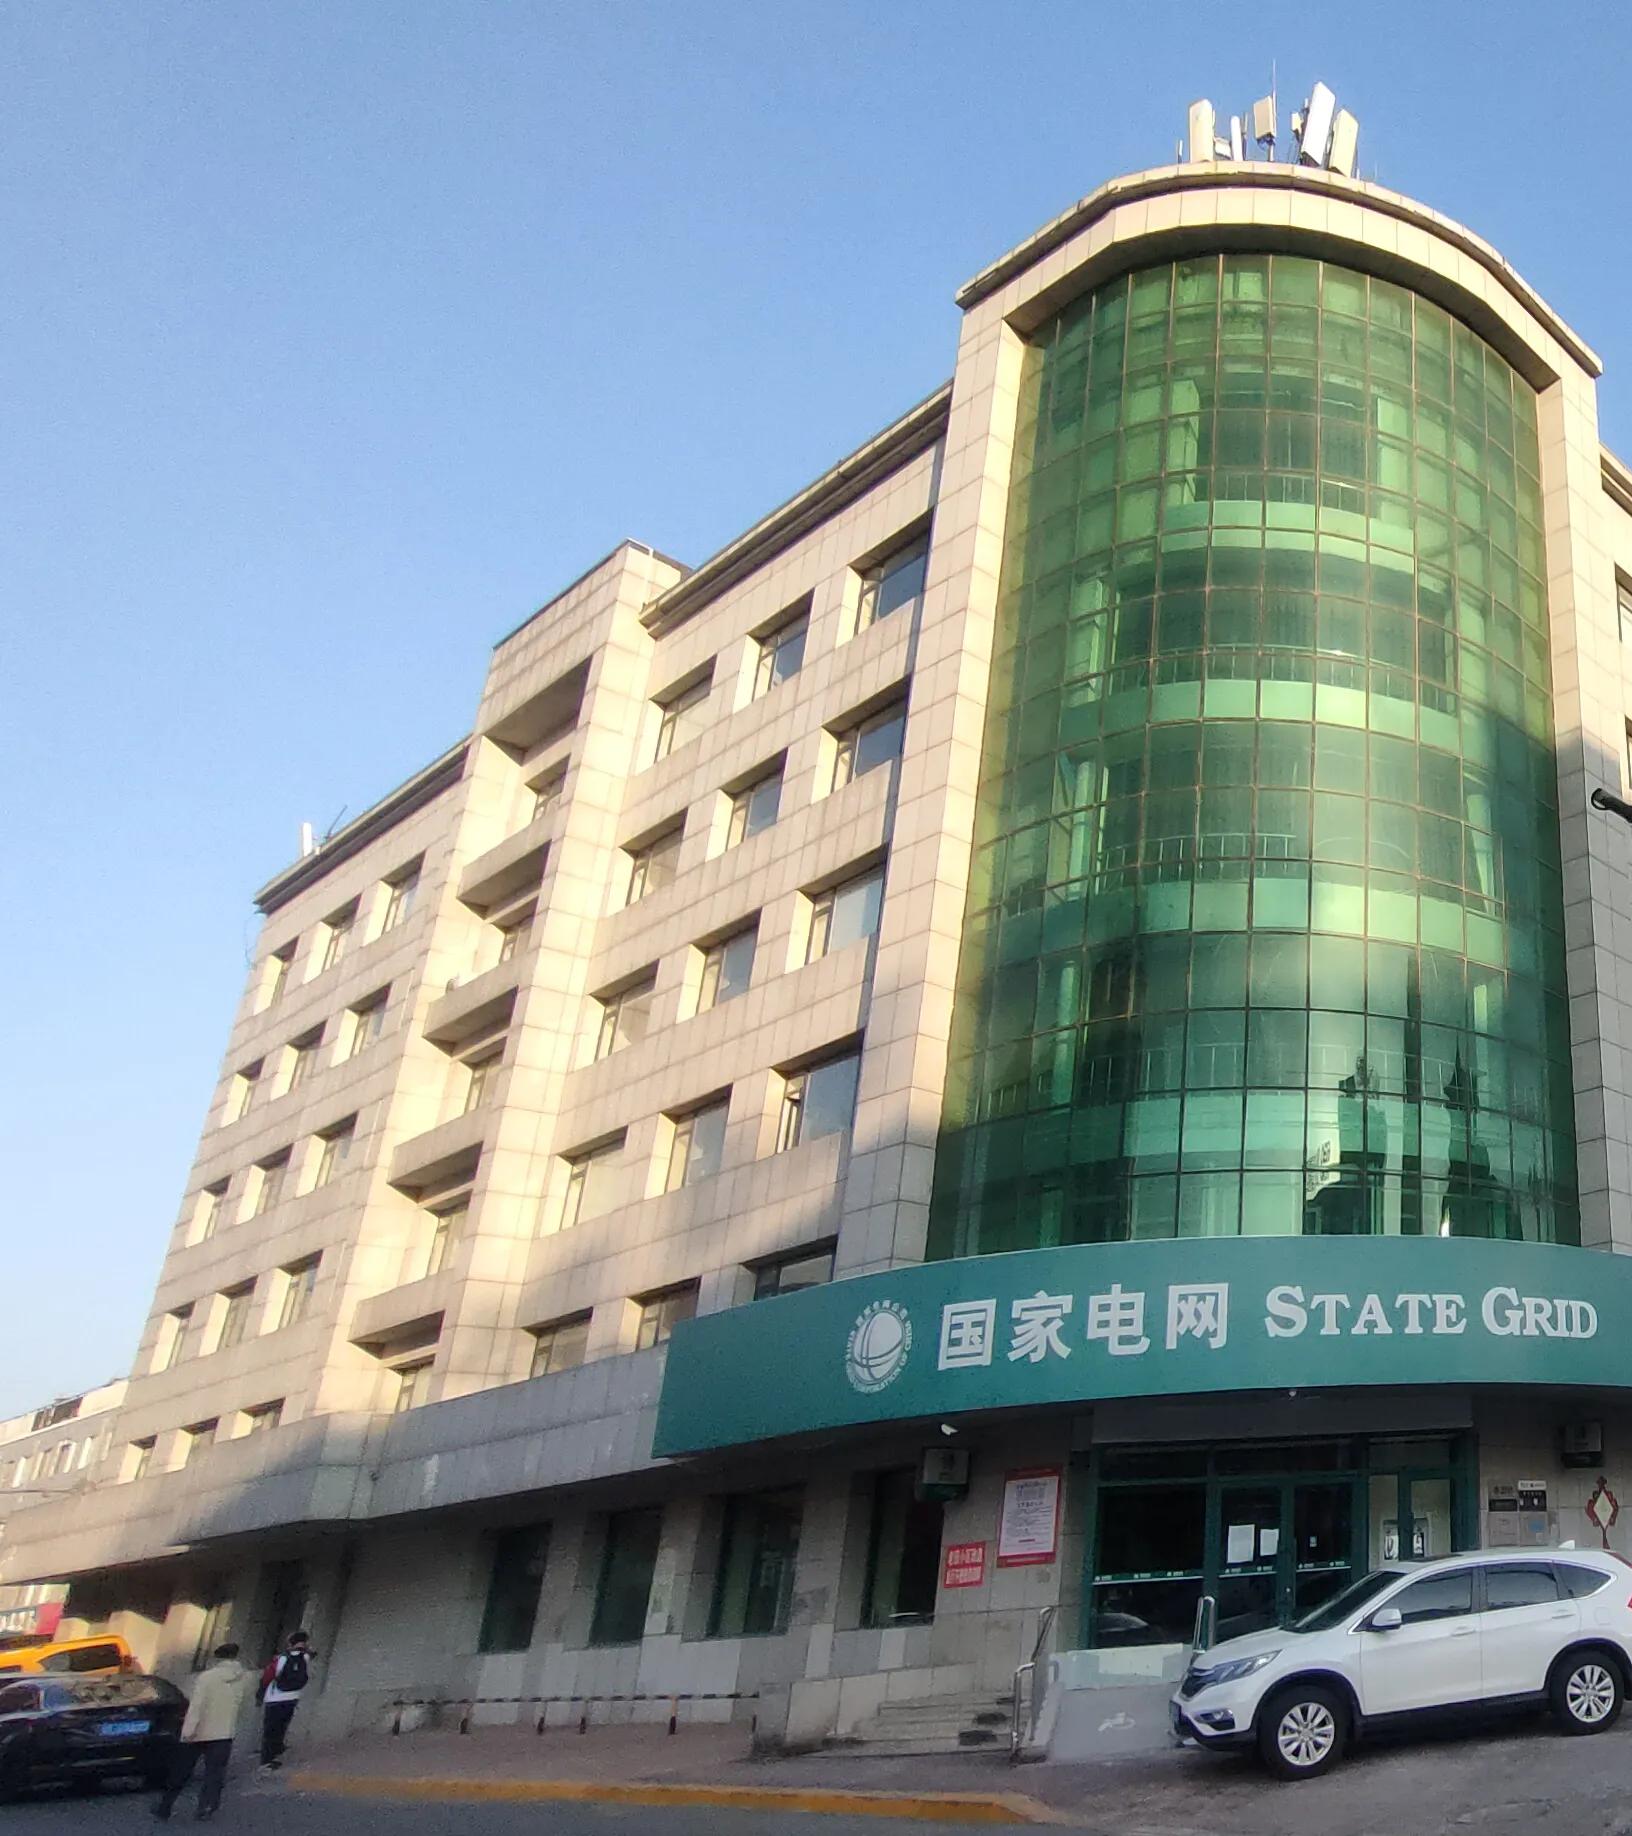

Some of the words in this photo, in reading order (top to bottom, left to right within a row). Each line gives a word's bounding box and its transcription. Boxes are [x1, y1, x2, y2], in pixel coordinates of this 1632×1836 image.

[938, 1283, 1229, 1370] 国家电网
[1264, 1285, 1467, 1338] STATE
[1481, 1286, 1598, 1339] GRID
